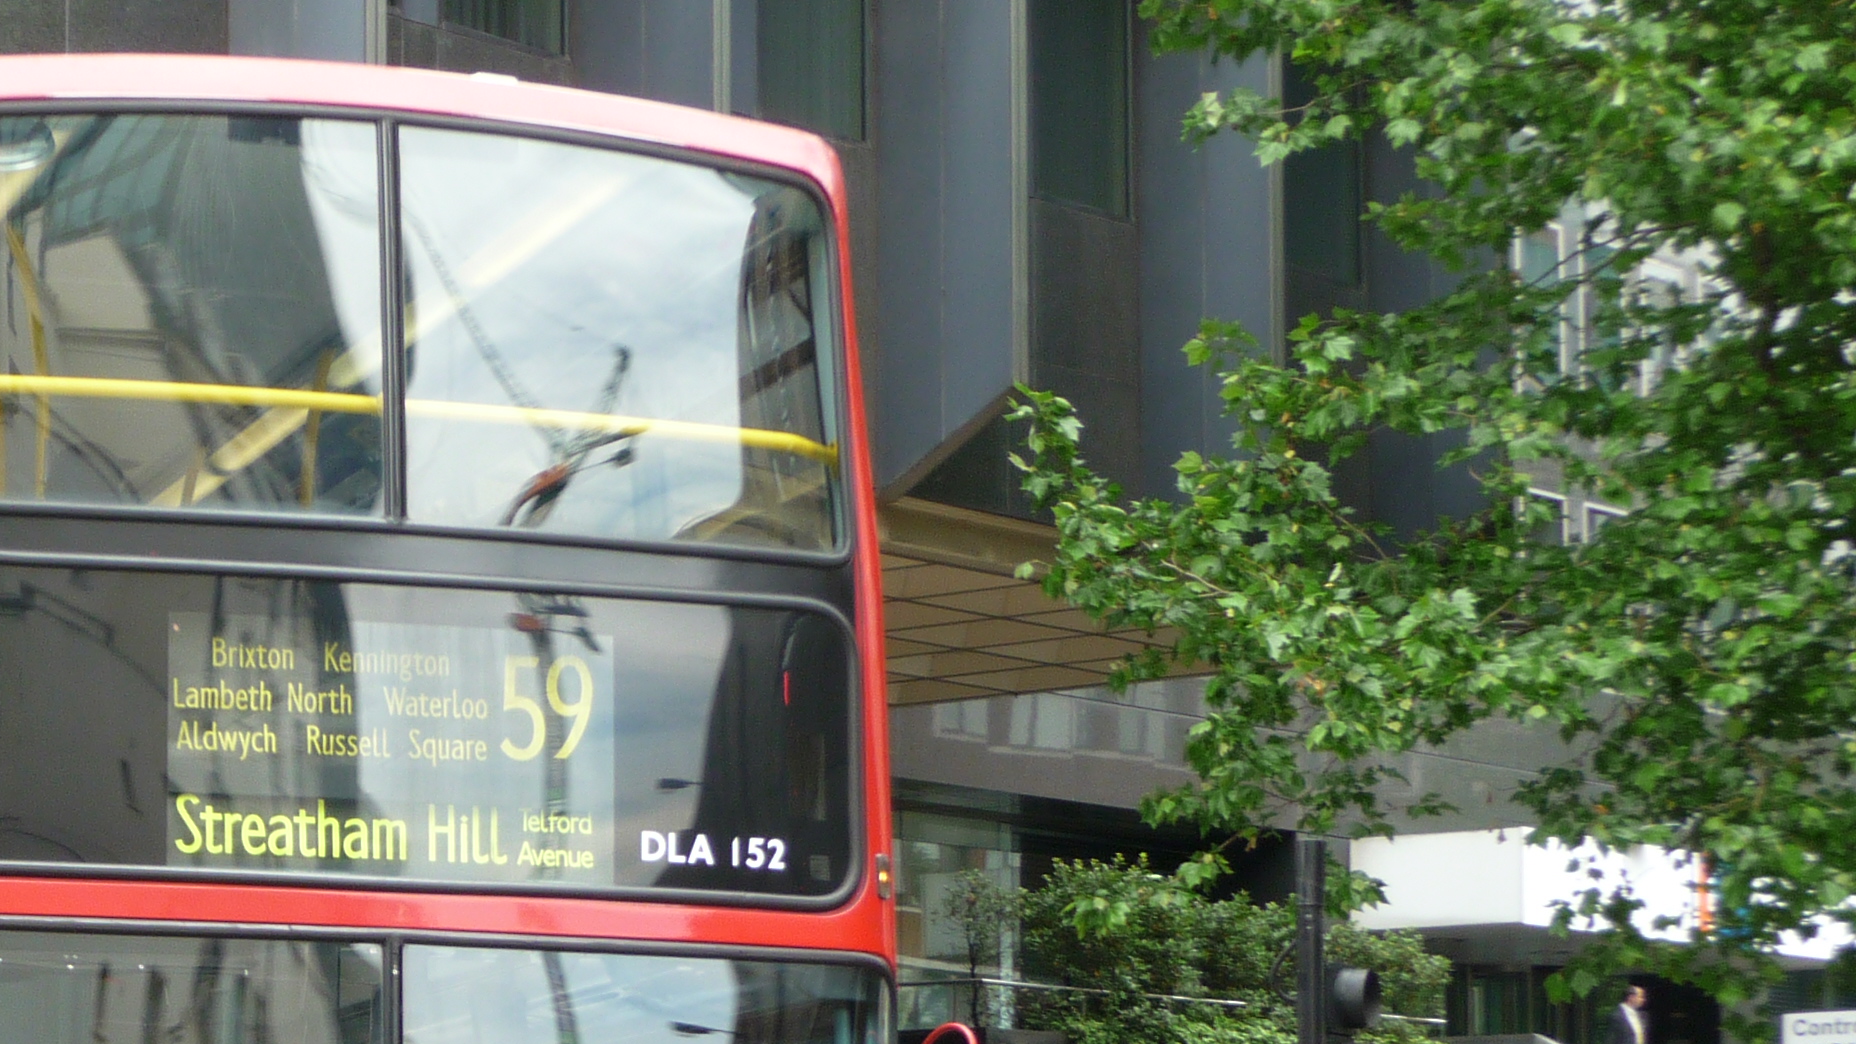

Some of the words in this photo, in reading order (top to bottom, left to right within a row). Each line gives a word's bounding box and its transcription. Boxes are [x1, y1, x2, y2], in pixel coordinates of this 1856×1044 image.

[212, 637, 294, 670] Brixton
[324, 641, 450, 682] Kennington
[173, 678, 272, 712] Lambeth
[288, 682, 352, 714] North
[383, 686, 488, 720] Waterloo
[500, 655, 593, 761] 59
[176, 720, 277, 760] Aldwych
[306, 725, 391, 758] Russell
[408, 729, 488, 767] Square
[175, 794, 407, 861] Streatham
[428, 804, 508, 864] Hill
[519, 808, 592, 834] Telford
[516, 841, 594, 868] Avenue
[641, 830, 714, 865] DLA
[731, 836, 786, 870] 152
